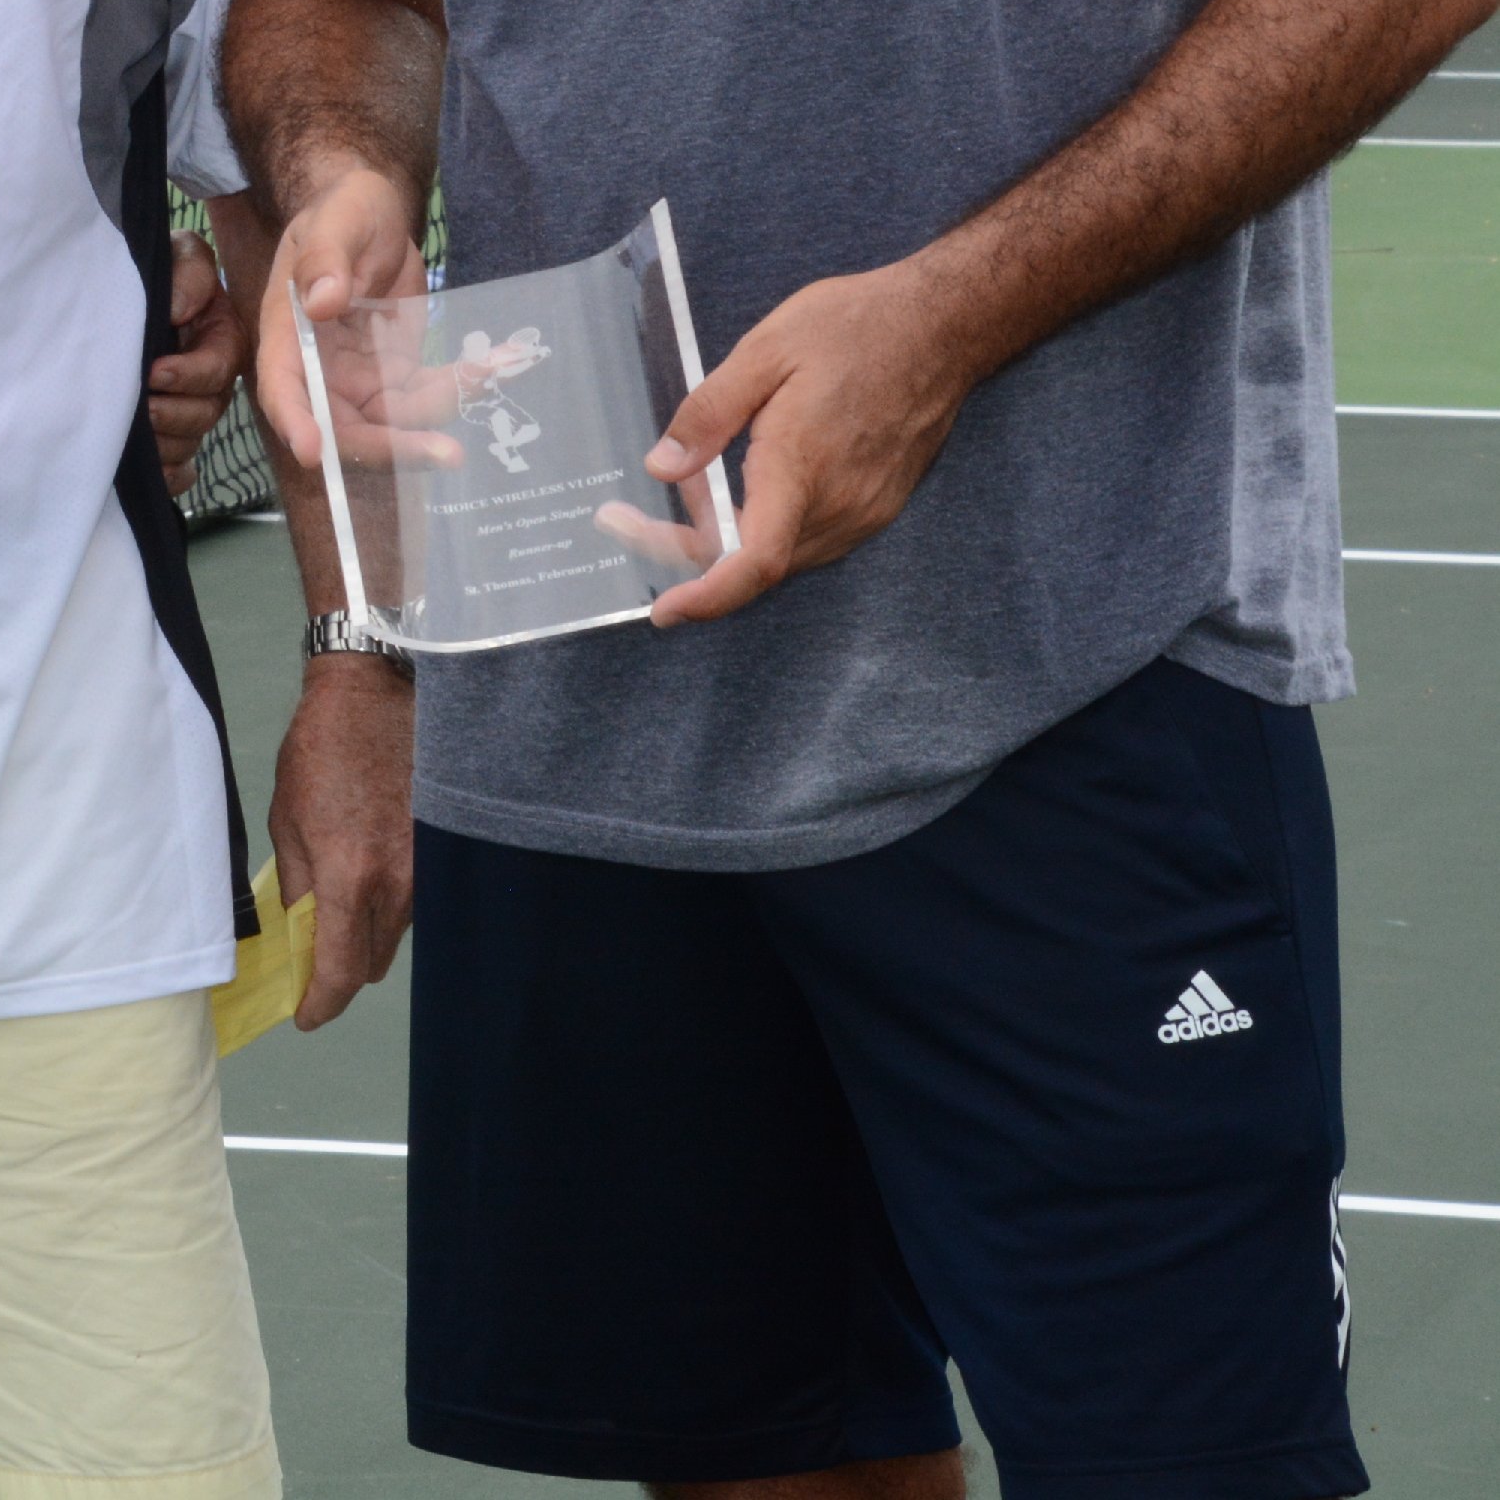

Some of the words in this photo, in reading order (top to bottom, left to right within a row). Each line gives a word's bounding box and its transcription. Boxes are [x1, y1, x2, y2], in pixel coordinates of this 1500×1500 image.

[433, 500, 489, 516] CHOICE
[491, 482, 566, 506] WIRELESS
[567, 479, 584, 491] VI
[586, 468, 624, 486] OPEN
[477, 520, 513, 537] Men's
[515, 514, 547, 530] Open
[549, 505, 593, 522] Singles
[508, 538, 573, 561] Runner-up
[464, 585, 481, 596] St.
[485, 575, 536, 593] Thomas,
[538, 561, 596, 582] February
[598, 554, 627, 570] 2015
[1157, 1009, 1254, 1044] adidas
